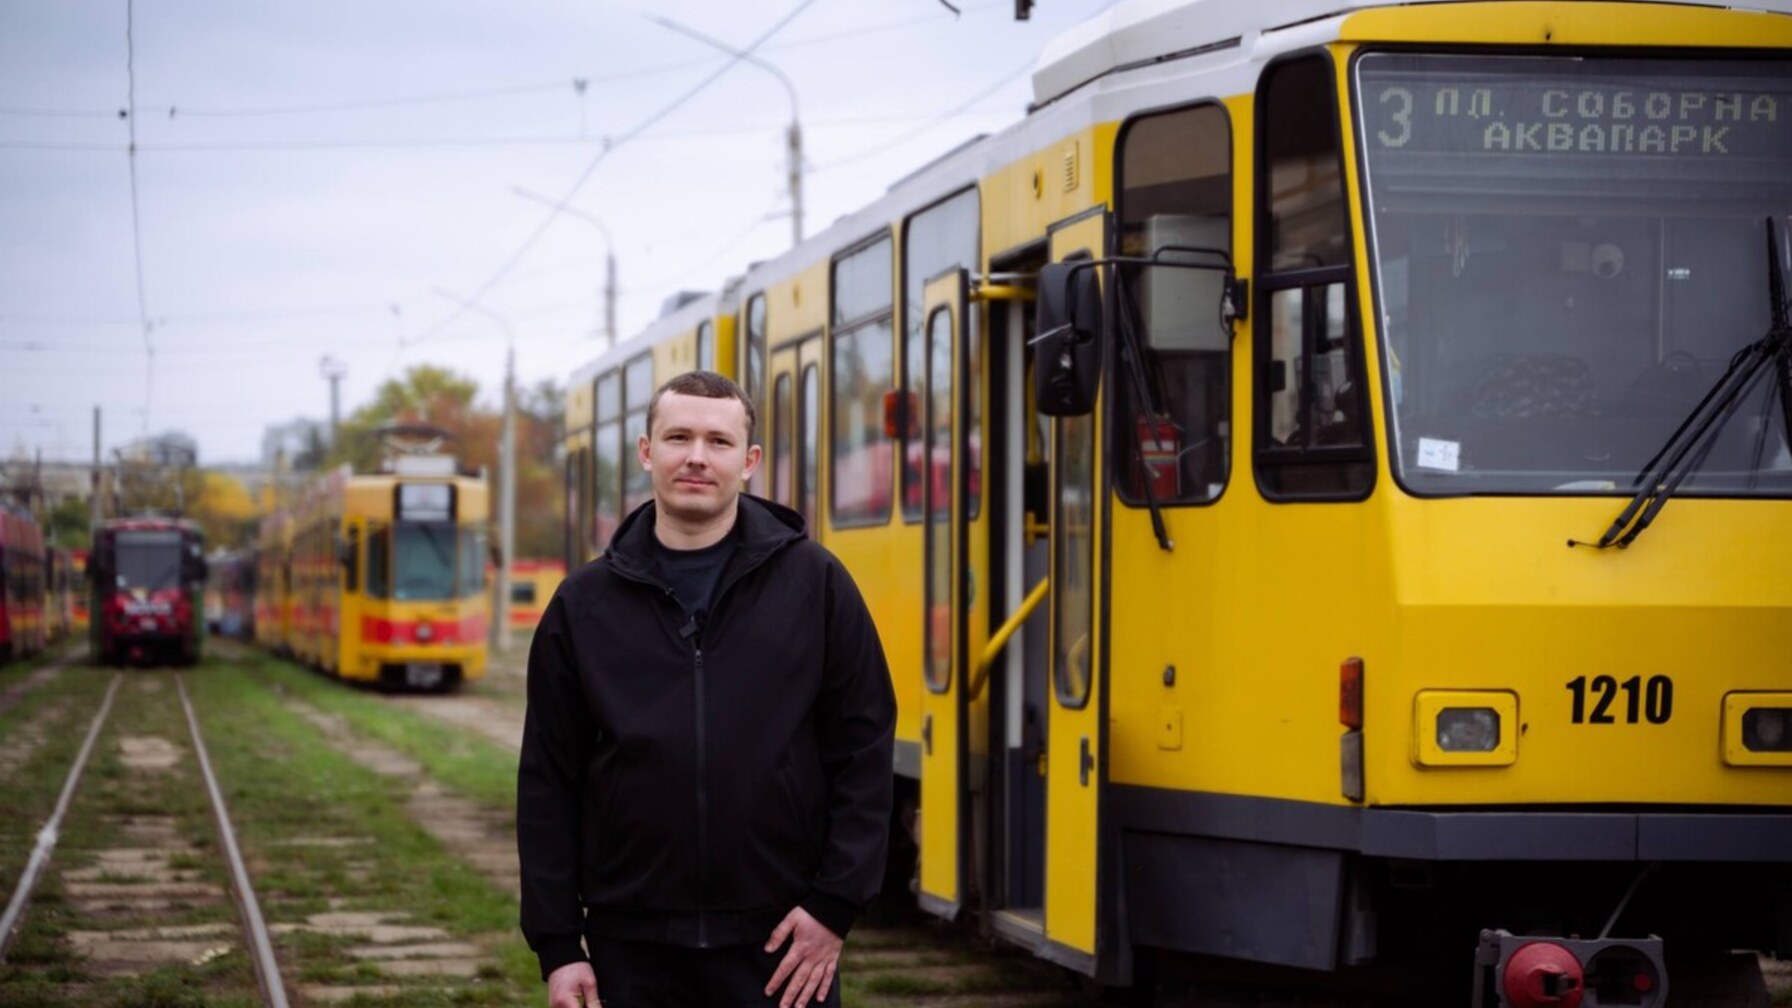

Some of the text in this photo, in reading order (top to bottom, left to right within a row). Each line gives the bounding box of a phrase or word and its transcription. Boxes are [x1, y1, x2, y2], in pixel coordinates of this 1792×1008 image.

[1378, 87, 1412, 147] 3
[1541, 90, 1777, 122] СОБОРНА
[1484, 122, 1730, 153] АКВАПАРК
[1566, 674, 1673, 725] 1210
